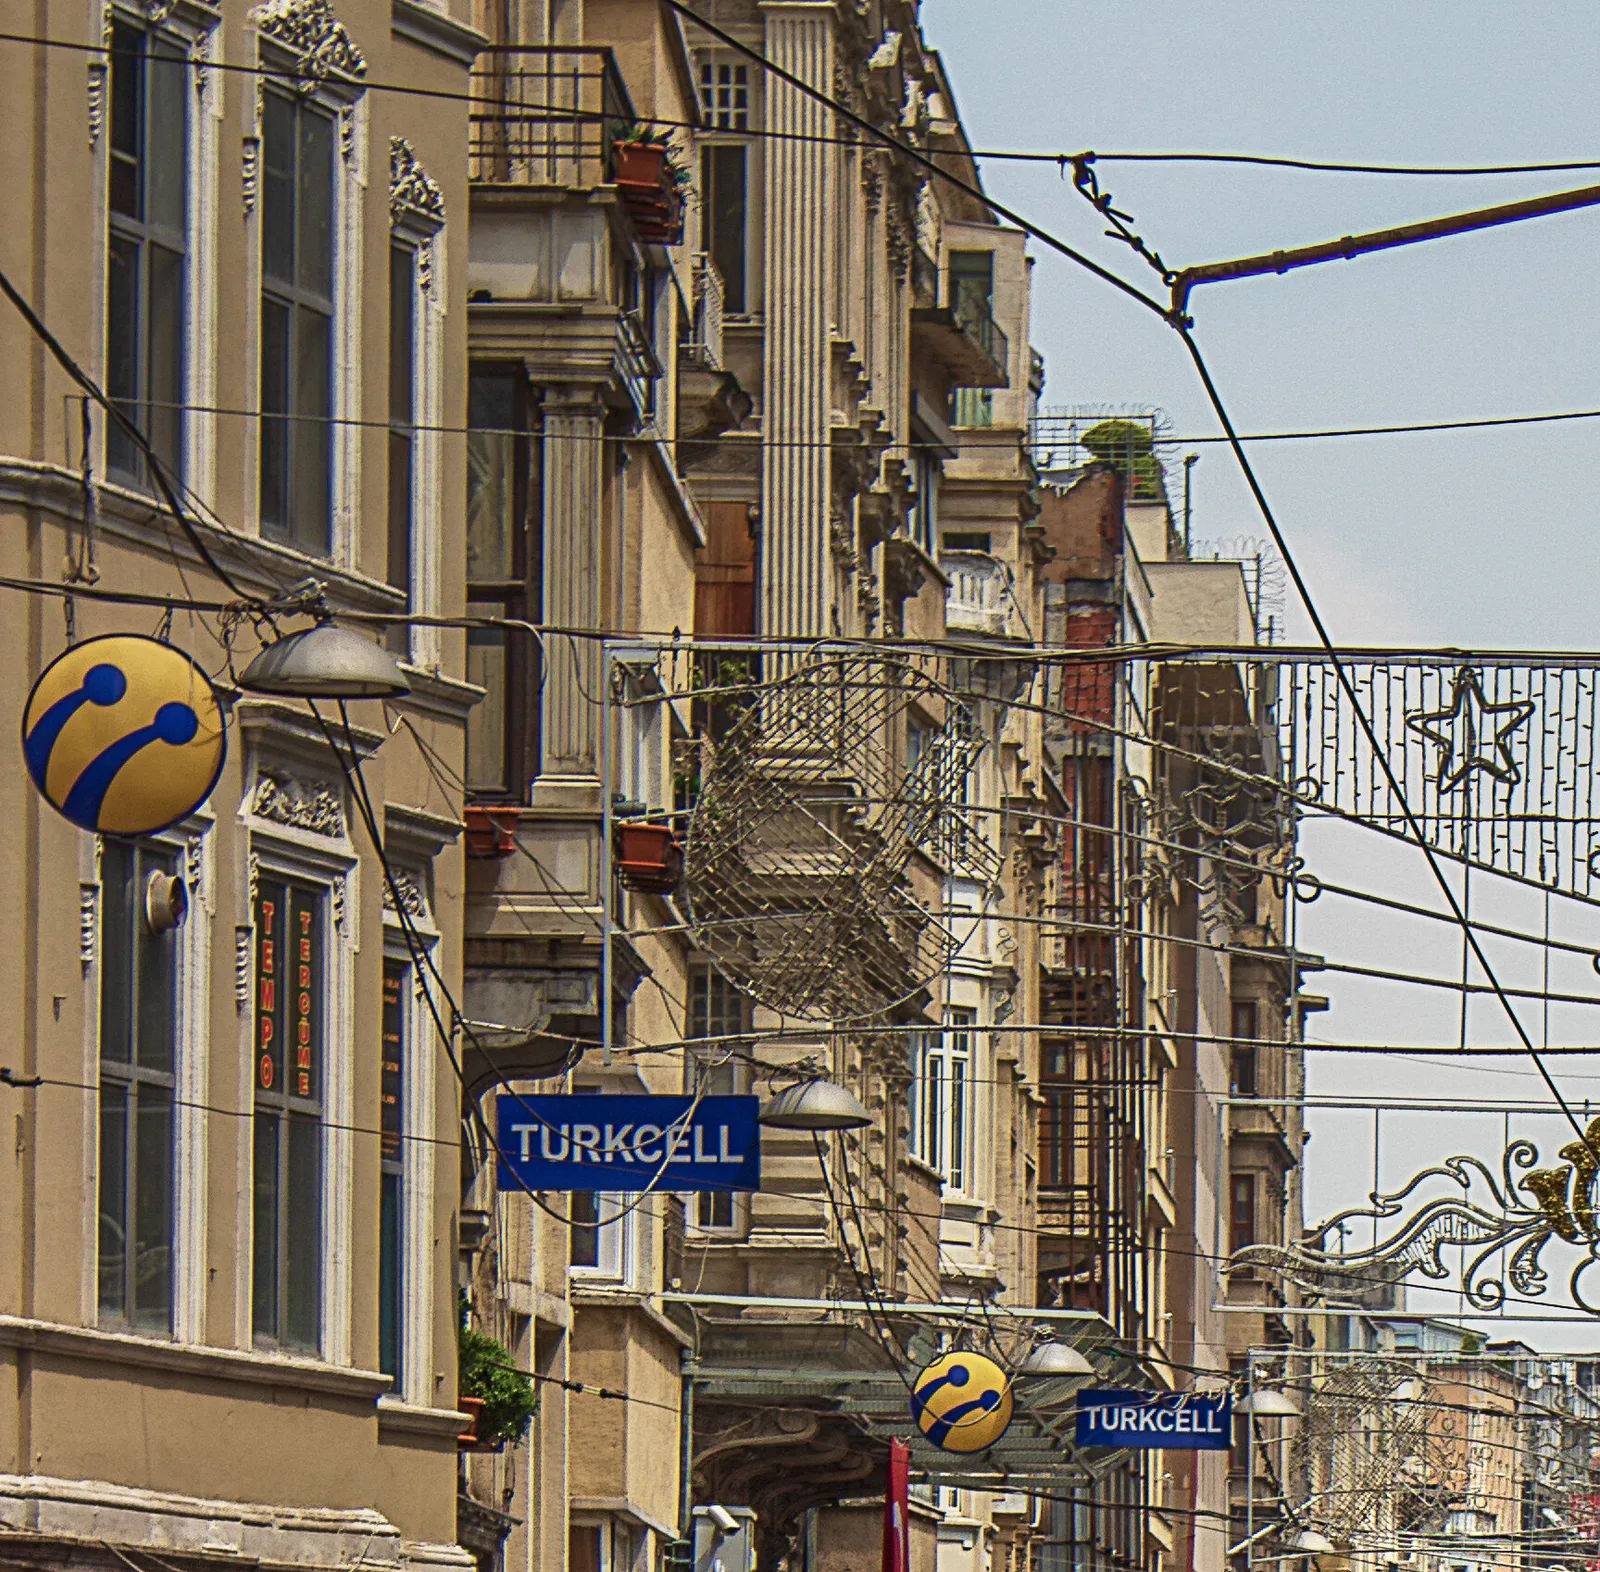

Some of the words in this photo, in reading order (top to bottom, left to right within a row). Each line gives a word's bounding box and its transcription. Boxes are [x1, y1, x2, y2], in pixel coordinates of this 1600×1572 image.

[260, 900, 275, 1089] TEMPO
[297, 911, 312, 1096] TERCÜME
[511, 1123, 744, 1163] TURKCELL
[1087, 1405, 1222, 1433] TURKCELL
